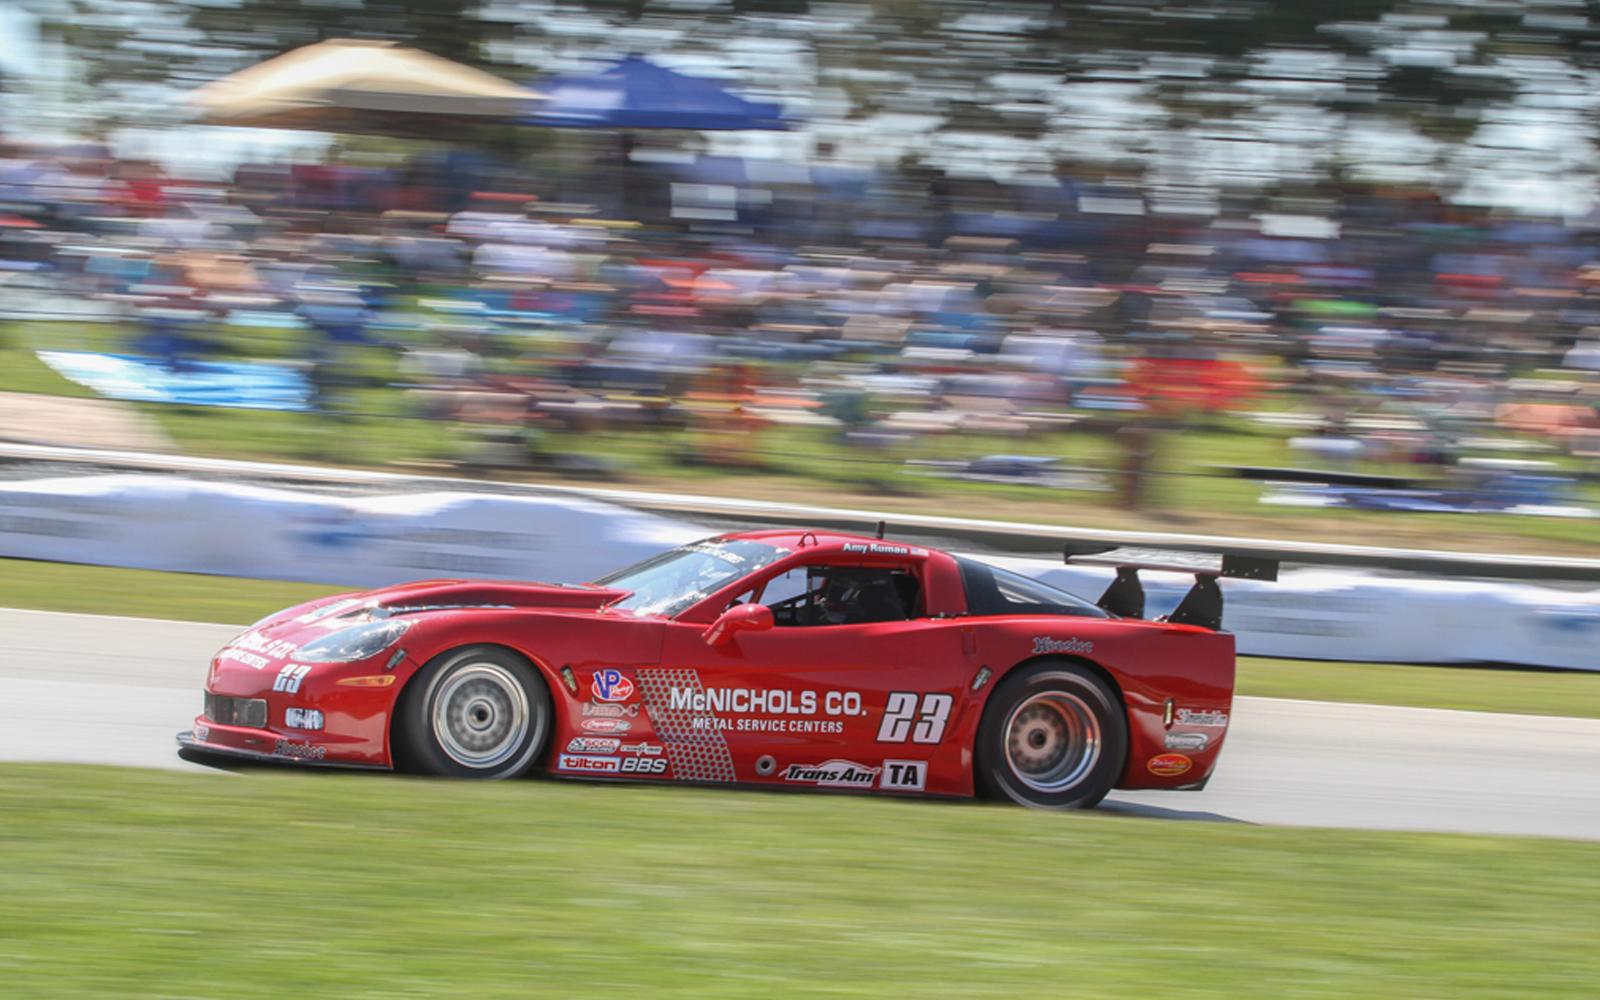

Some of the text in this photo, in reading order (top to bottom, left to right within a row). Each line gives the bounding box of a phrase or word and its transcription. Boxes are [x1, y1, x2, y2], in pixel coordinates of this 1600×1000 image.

[843, 542, 908, 555] Amy Ruman
[273, 663, 312, 694] 23
[593, 670, 620, 699] VP
[670, 687, 817, 715] McNICHOLS
[824, 690, 867, 716] CO.
[692, 717, 843, 733] METAL SERVICE CENTERS
[876, 691, 954, 744] 23
[563, 757, 616, 769] tilton
[621, 757, 668, 773] BBS
[786, 764, 875, 784] Trans Am
[889, 764, 919, 786] TA
